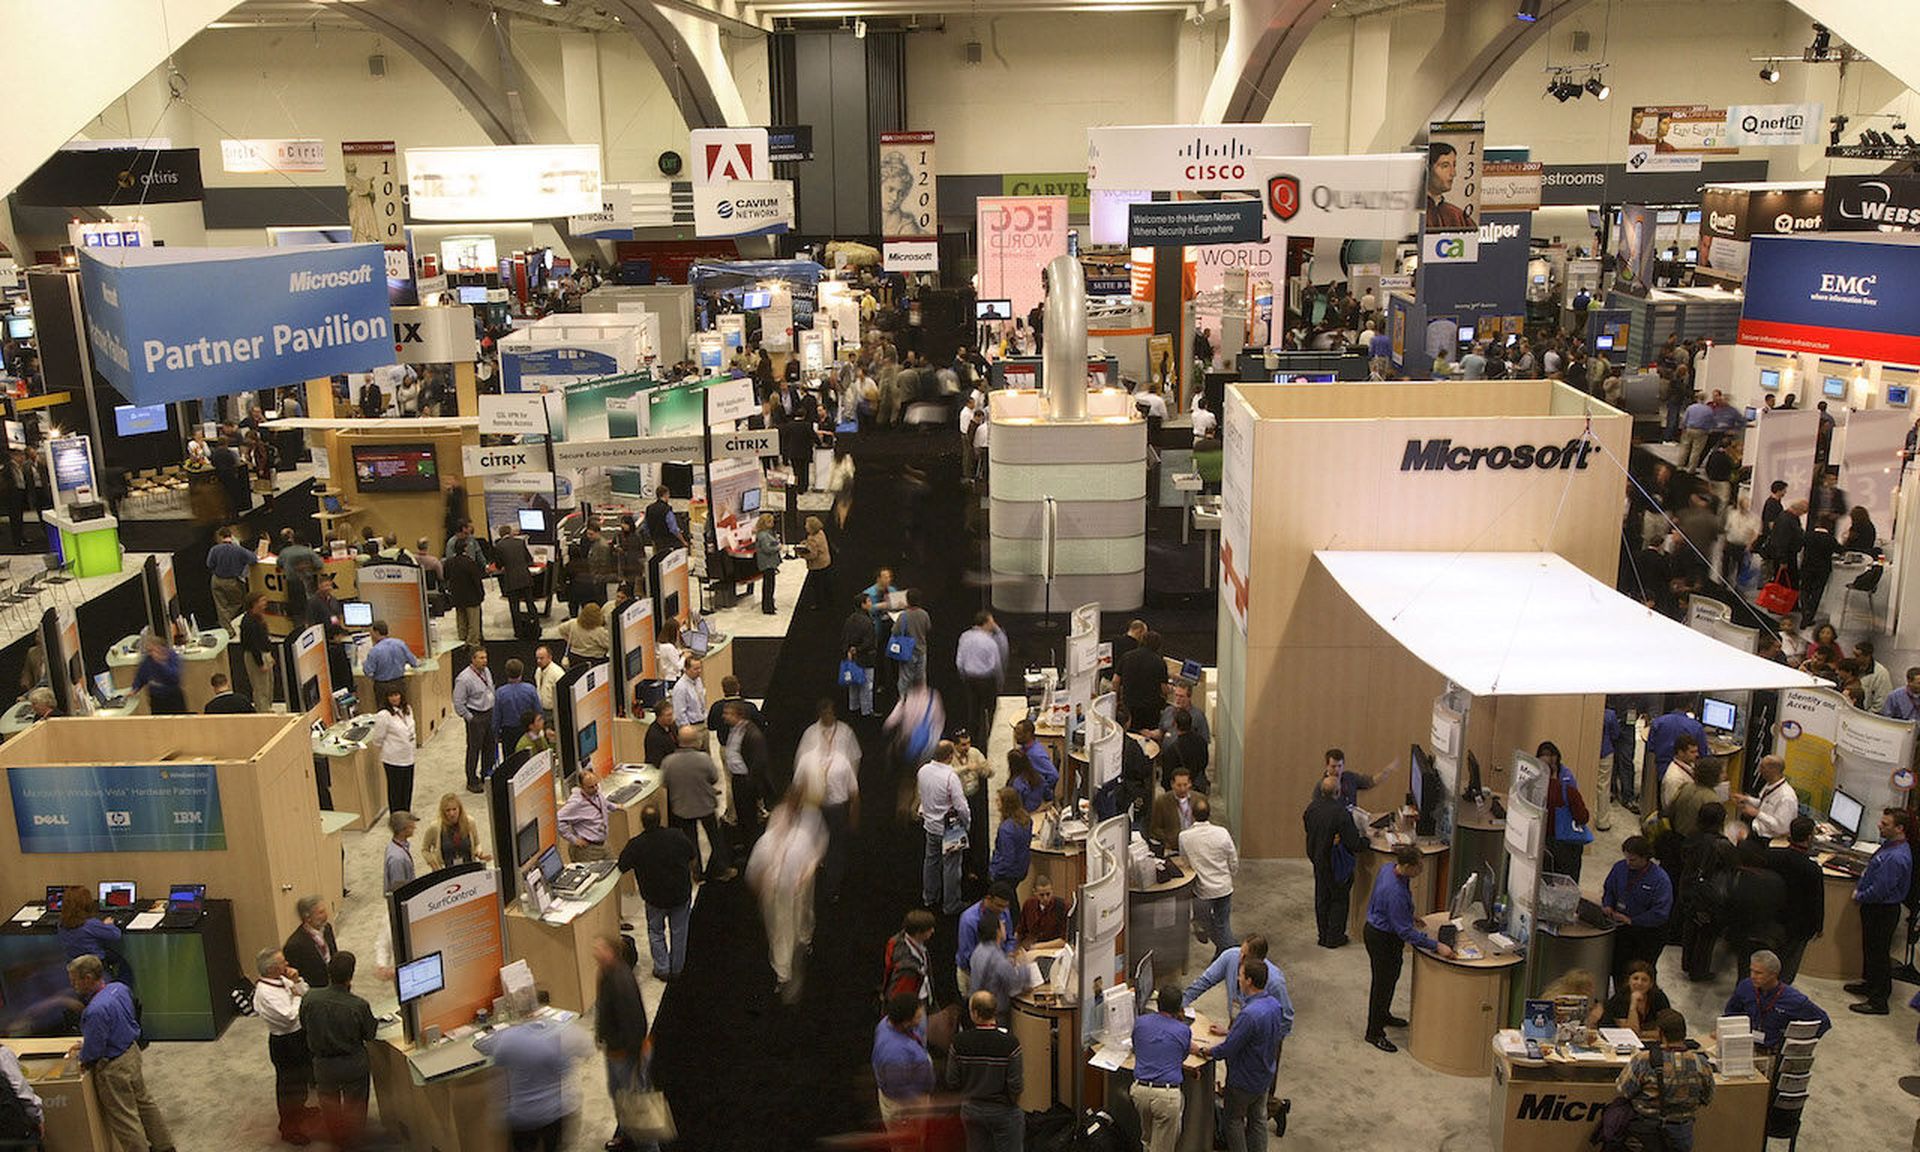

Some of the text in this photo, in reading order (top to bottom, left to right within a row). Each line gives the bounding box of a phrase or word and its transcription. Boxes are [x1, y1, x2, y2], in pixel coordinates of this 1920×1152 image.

[140, 170, 179, 185] altiris
[1185, 165, 1245, 180] CISCO
[1541, 172, 1605, 187] estrooms
[918, 150, 930, 228] 1200
[382, 161, 398, 237] 1000
[736, 199, 779, 209] CAVIUM
[736, 209, 779, 219] NETWORKS
[1133, 212, 1241, 225] Welcome to the Human Network
[1132, 226, 1156, 237] Where
[1157, 226, 1186, 238] Security
[1194, 225, 1234, 236] Everywhere
[86, 233, 138, 247] PGP
[888, 252, 932, 261] Microsoft
[1202, 249, 1273, 266] WORLD
[289, 263, 374, 293] Microsoft
[143, 334, 264, 373] Partner
[272, 313, 389, 356] Pavilion
[559, 444, 699, 460] Secure End-to-End Application Delivery
[1400, 438, 1592, 471] Microsoft
[1786, 701, 1815, 712] Access
[1787, 692, 1836, 711] Identity and
[132, 787, 172, 797] Hardware
[173, 787, 208, 796] Partners
[33, 814, 70, 826] DELL
[173, 811, 203, 824] IBM
[427, 888, 478, 912] SurfControl
